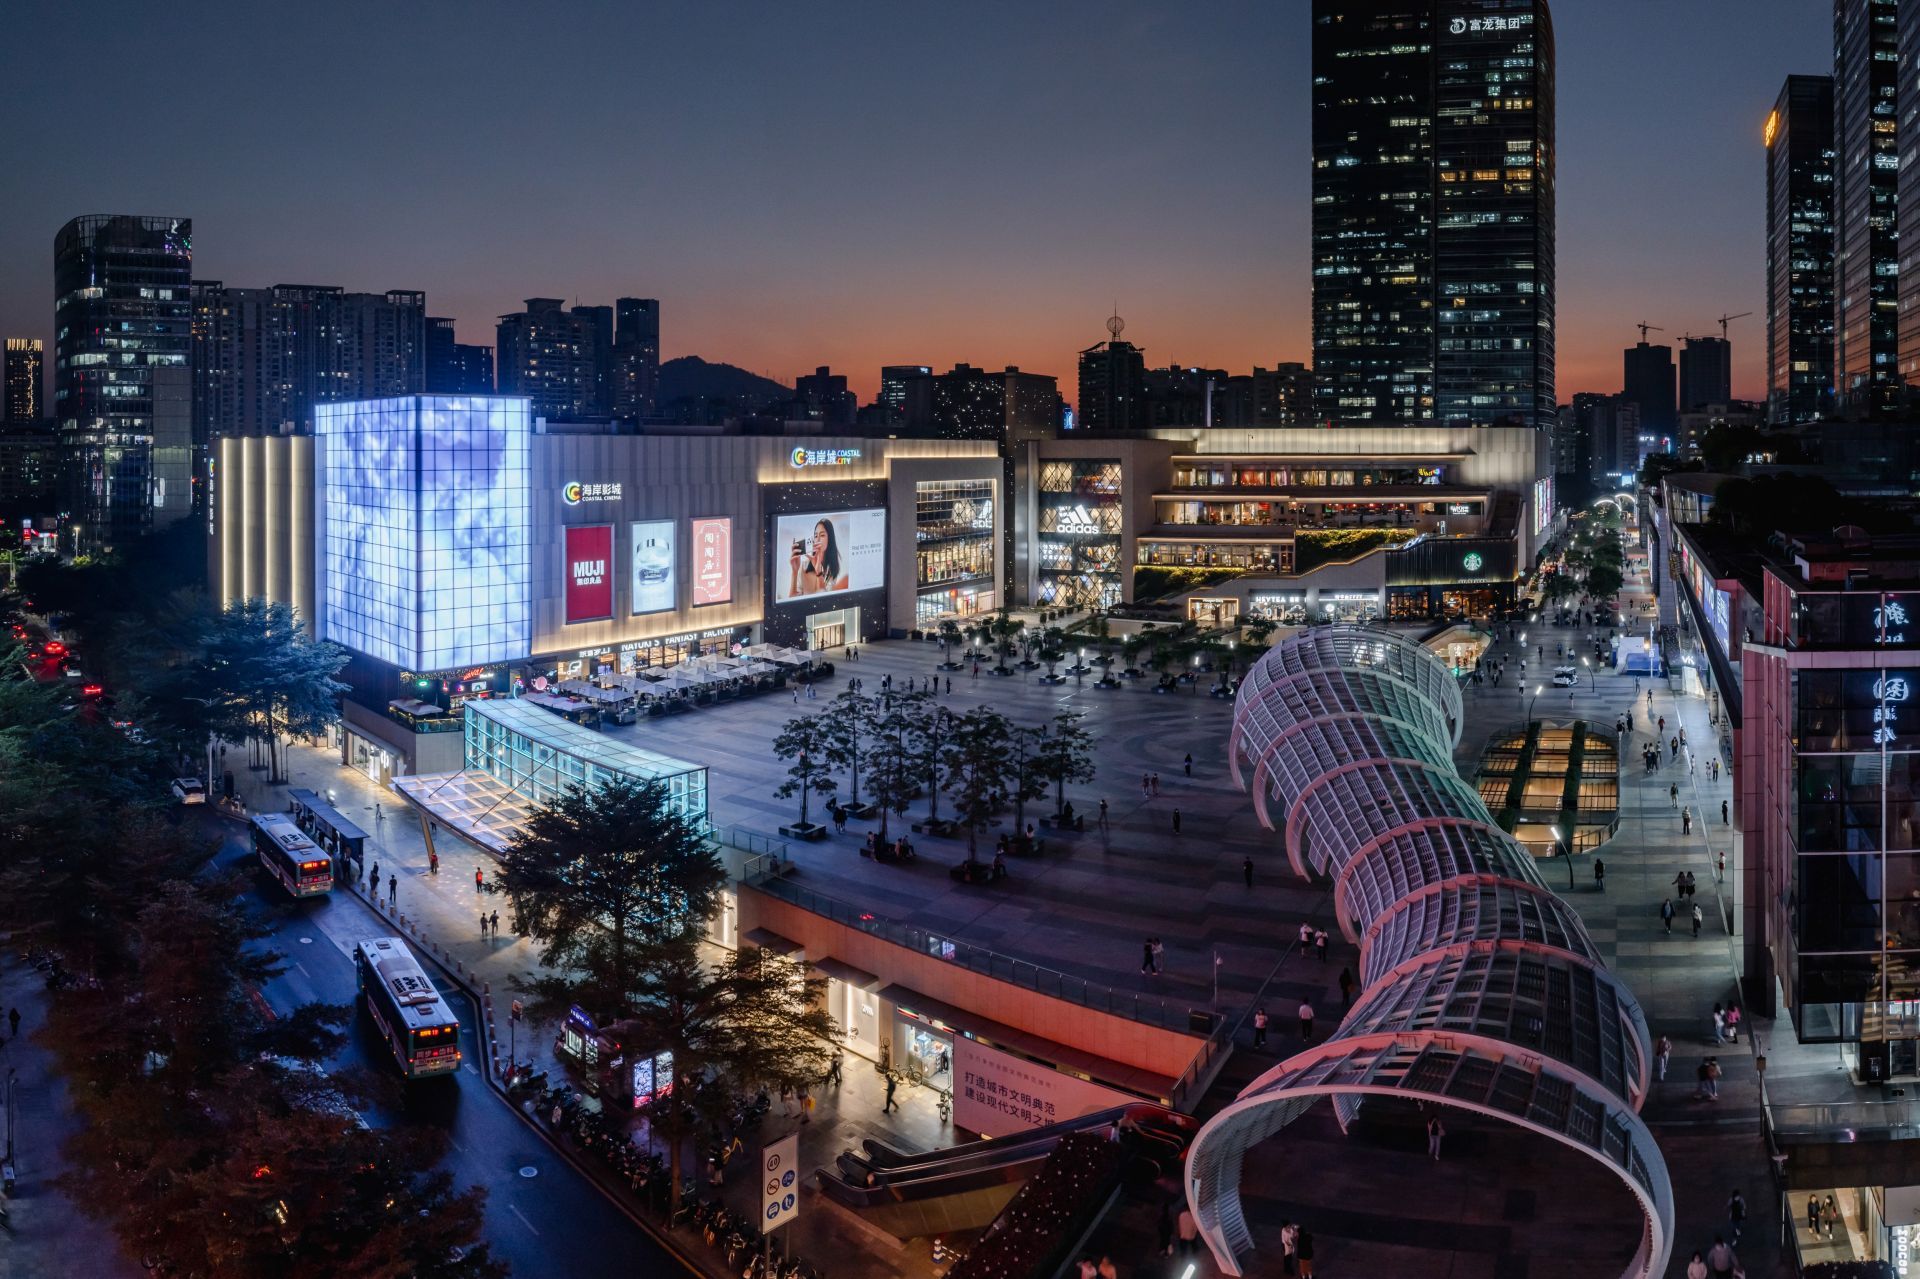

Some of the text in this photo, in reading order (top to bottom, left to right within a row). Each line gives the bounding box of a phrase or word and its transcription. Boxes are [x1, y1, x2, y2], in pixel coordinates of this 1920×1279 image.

[1469, 18, 1520, 31] 富龙集团
[804, 449, 837, 465] 海岸城
[837, 449, 861, 457] COASTAL
[837, 457, 851, 465] CITY
[582, 483, 622, 496] 海岸影城
[1056, 523, 1100, 534] adidas
[573, 559, 605, 578] MUJI
[965, 1071, 1056, 1116] 打造城市文明典范
